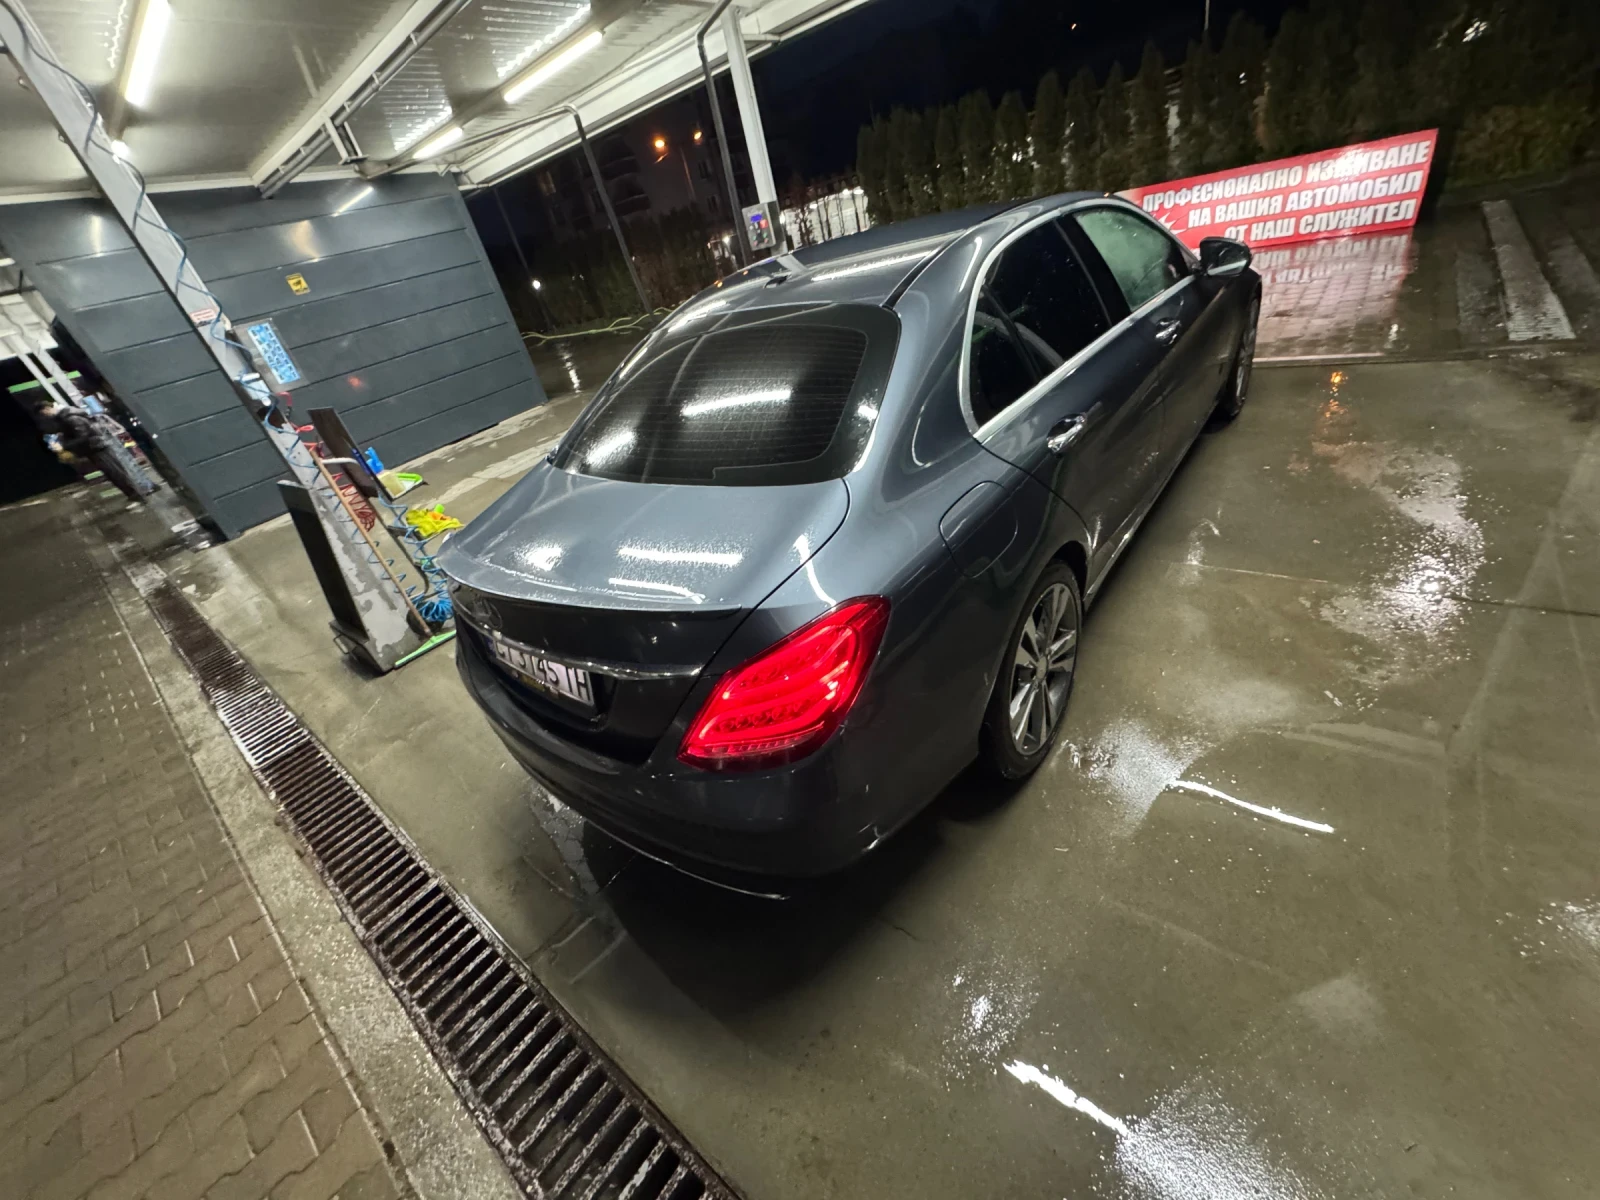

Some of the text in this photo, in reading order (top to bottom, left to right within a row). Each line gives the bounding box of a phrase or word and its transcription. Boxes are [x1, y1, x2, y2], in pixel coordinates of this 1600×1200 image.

[1142, 165, 1303, 213] ПРОФЕСИОНАЛНО
[1187, 170, 1424, 229] НА ВАШИЯ АВТОМОБИЛ
[1224, 198, 1418, 242] ОТ НАШ СЛУЖИТЕЛ
